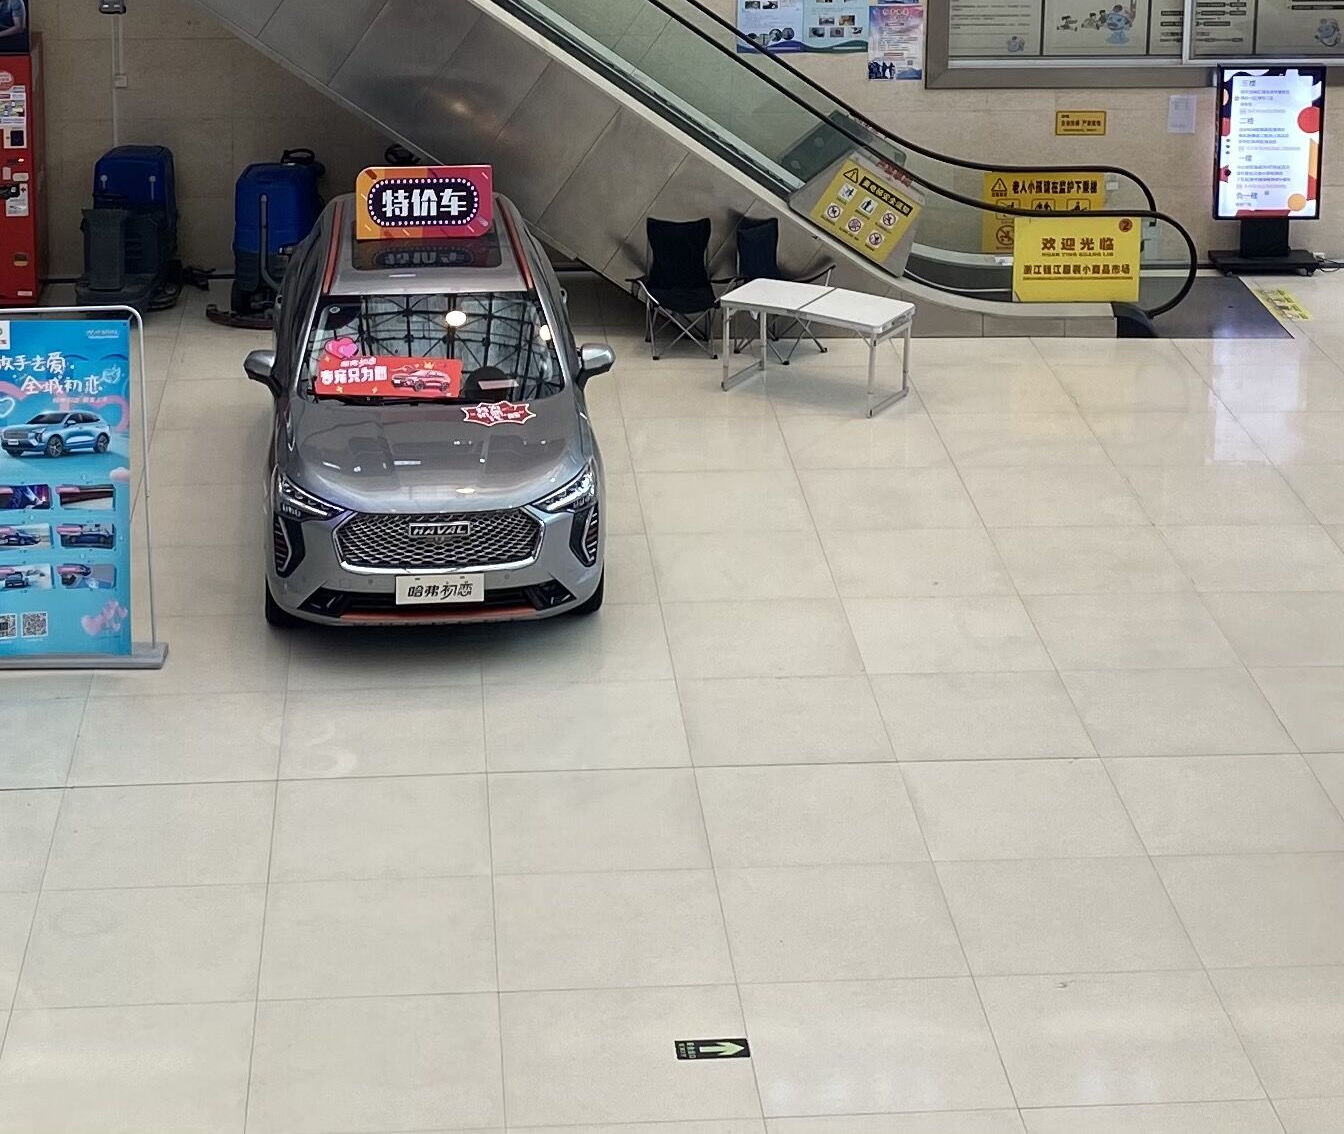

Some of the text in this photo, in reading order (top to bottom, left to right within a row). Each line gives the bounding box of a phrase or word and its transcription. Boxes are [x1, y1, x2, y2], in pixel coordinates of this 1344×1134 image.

[382, 188, 467, 217] 特价车
[1041, 237, 1114, 251] 欢迎光临
[21, 375, 100, 395] 全城初恋
[412, 525, 466, 535] HAVAL
[407, 581, 473, 600] 哈弗初恋
